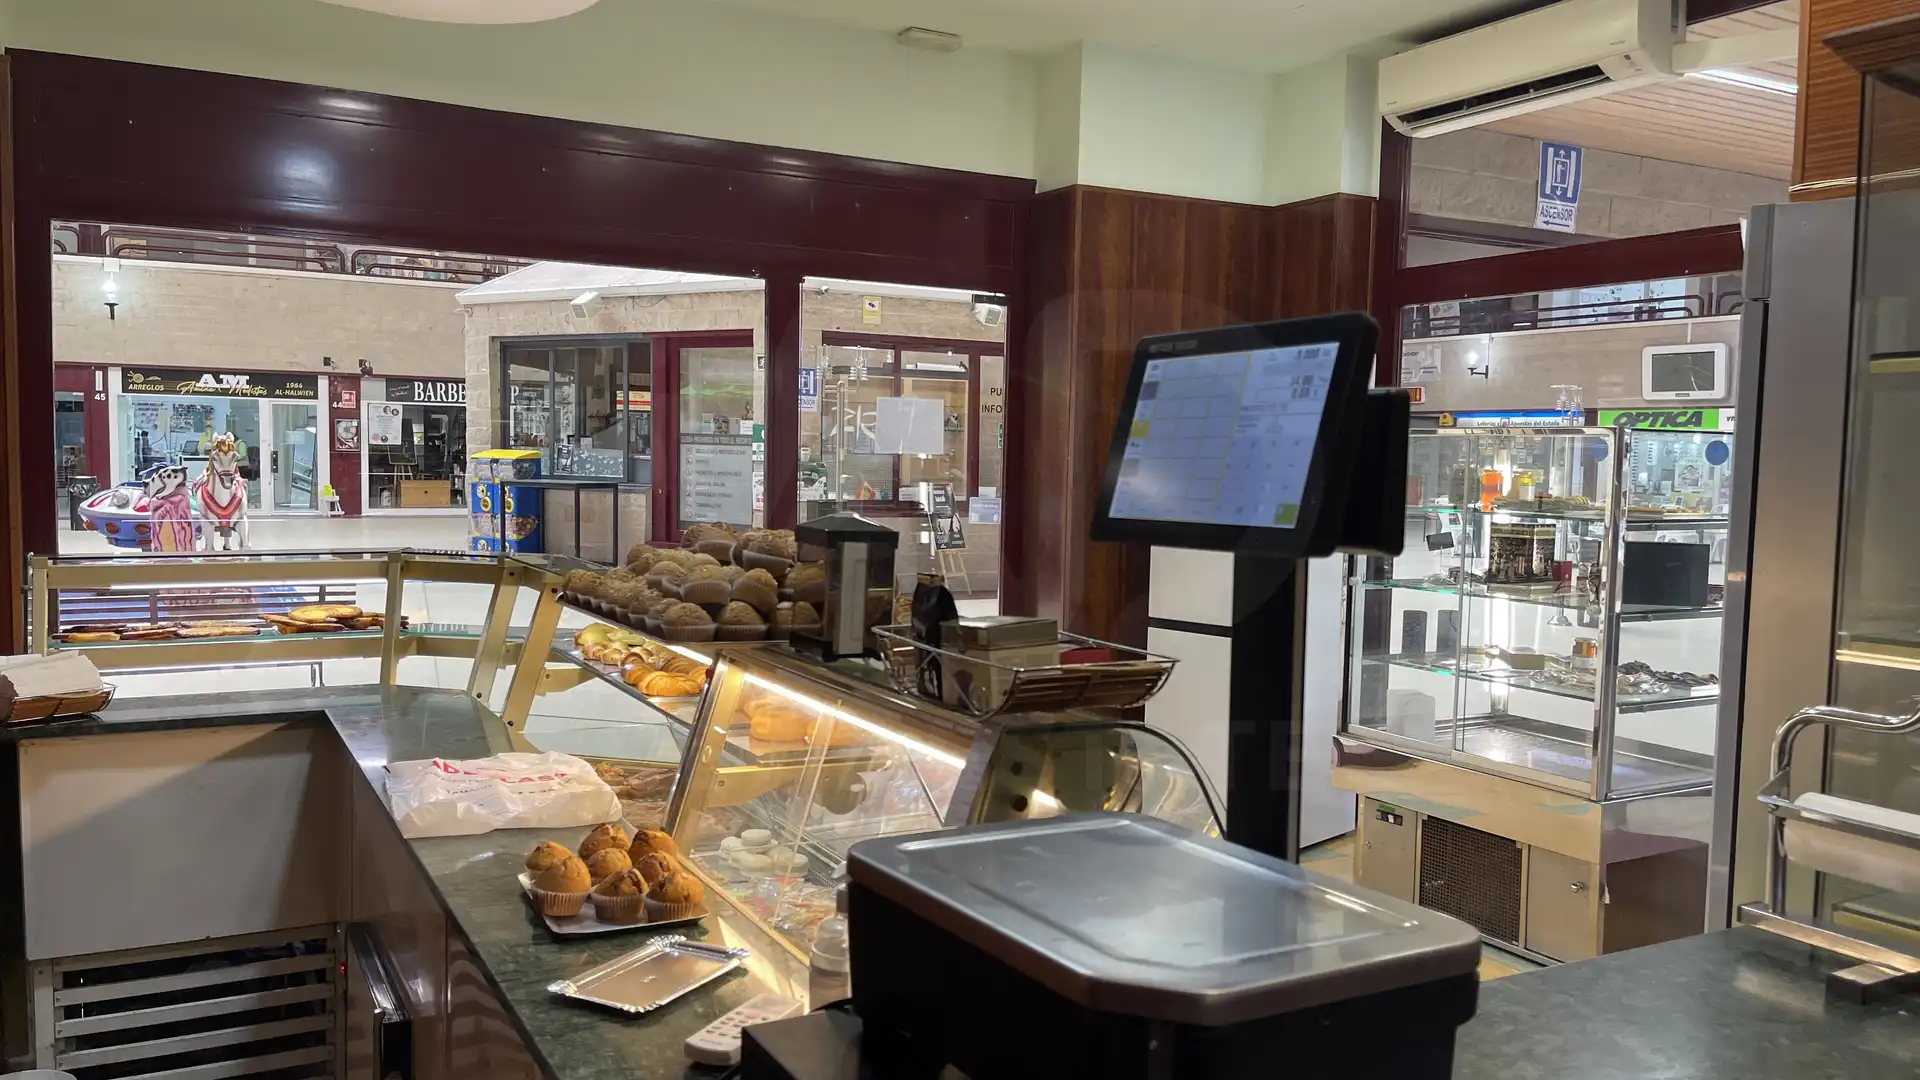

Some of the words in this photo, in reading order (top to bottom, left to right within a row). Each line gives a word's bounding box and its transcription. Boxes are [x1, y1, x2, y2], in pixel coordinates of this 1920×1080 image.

[1540, 204, 1573, 221] ASCENSOR
[196, 373, 250, 389] AM
[128, 383, 165, 391] ARREGLOS
[94, 393, 106, 401] 45
[981, 404, 1003, 413] INFO
